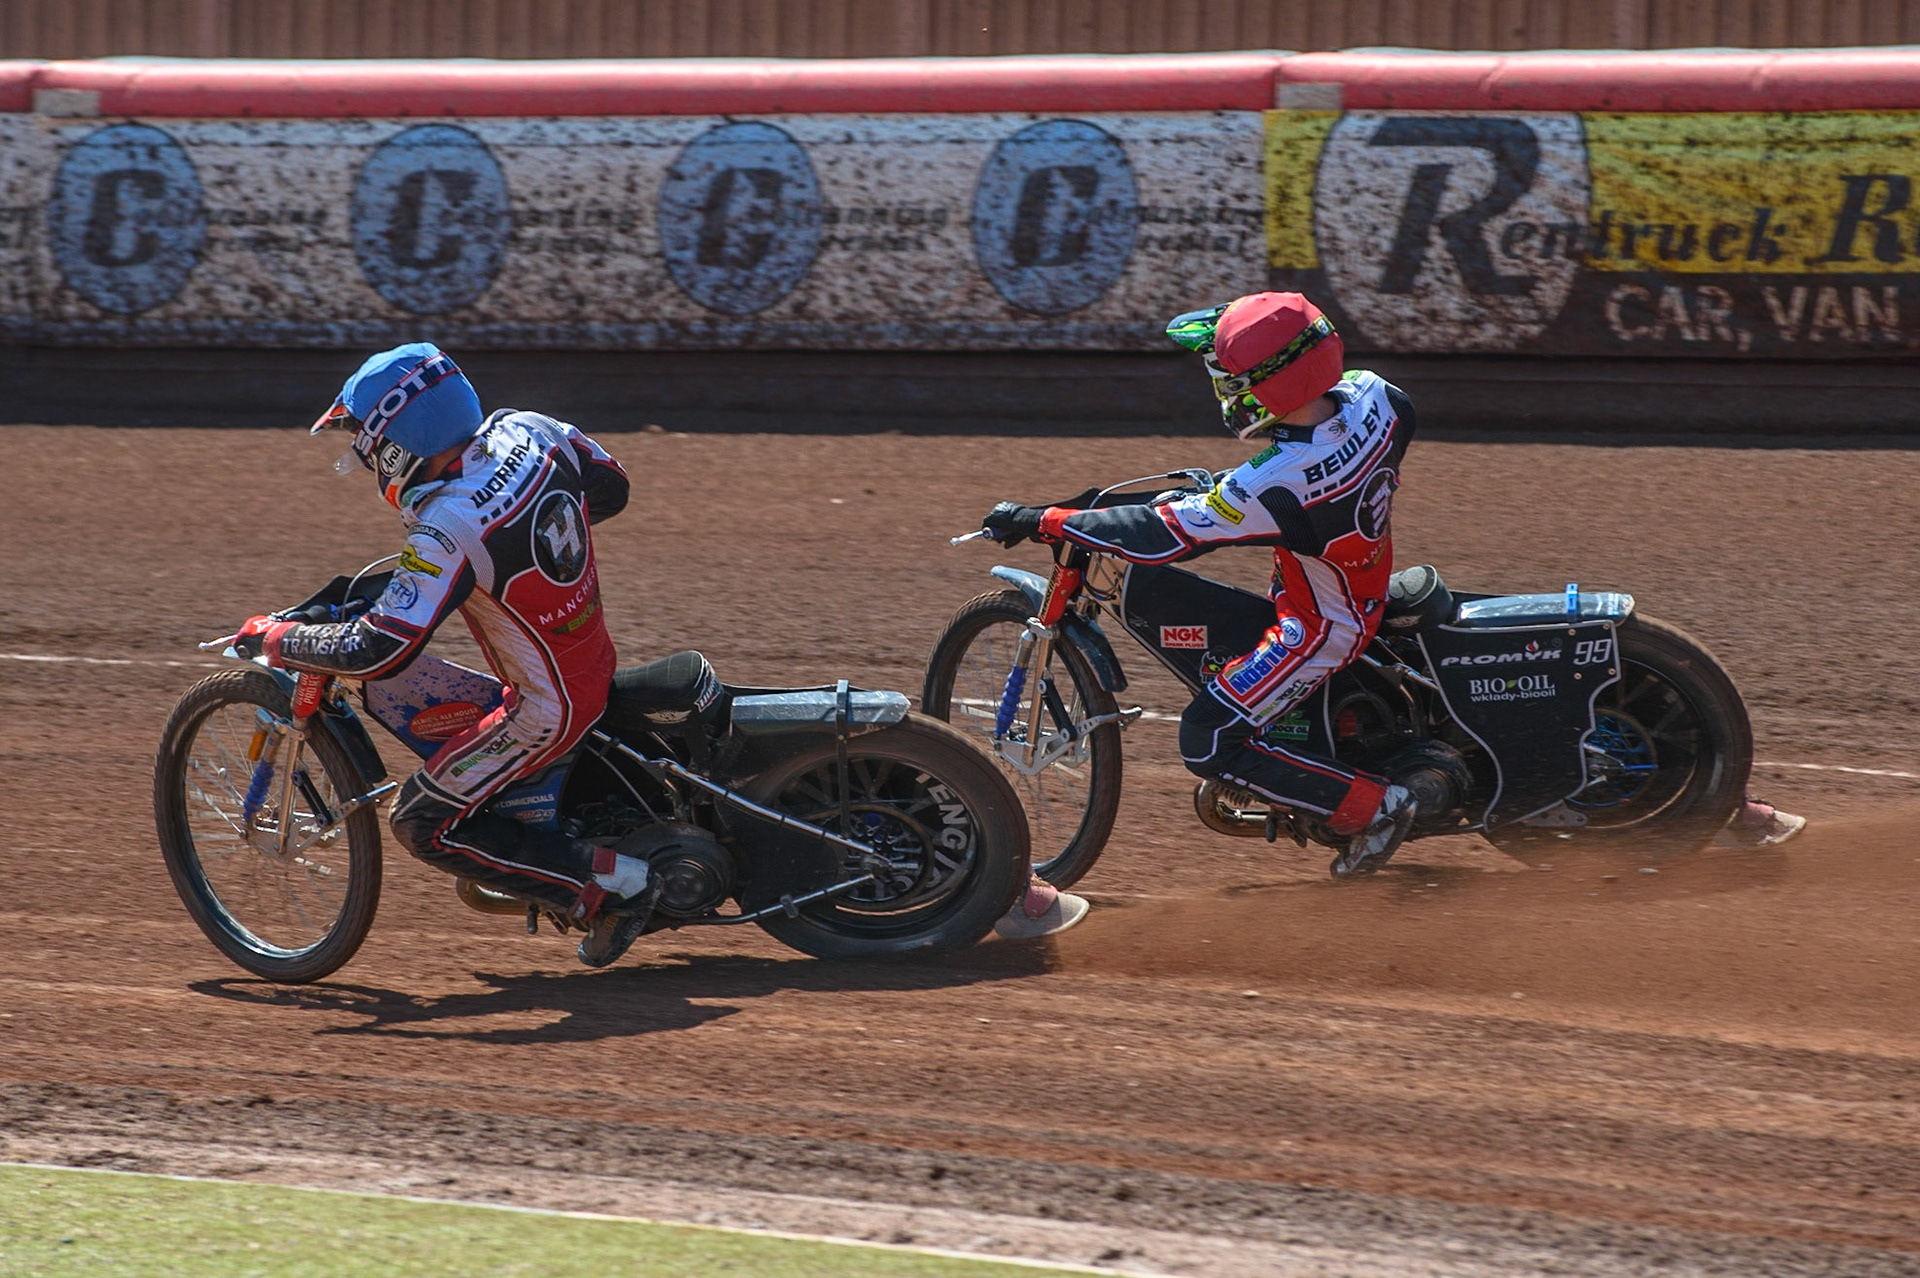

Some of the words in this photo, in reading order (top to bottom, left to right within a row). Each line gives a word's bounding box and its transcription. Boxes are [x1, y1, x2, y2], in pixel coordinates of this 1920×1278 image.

[1805, 174, 1920, 266] R
[355, 354, 448, 453] SCOTT
[1303, 401, 1381, 484] BEWLEY
[1164, 628, 1204, 641] NGK
[1573, 639, 1612, 666] 99
[1469, 678, 1506, 695] BIO
[1518, 675, 1555, 691] OIL
